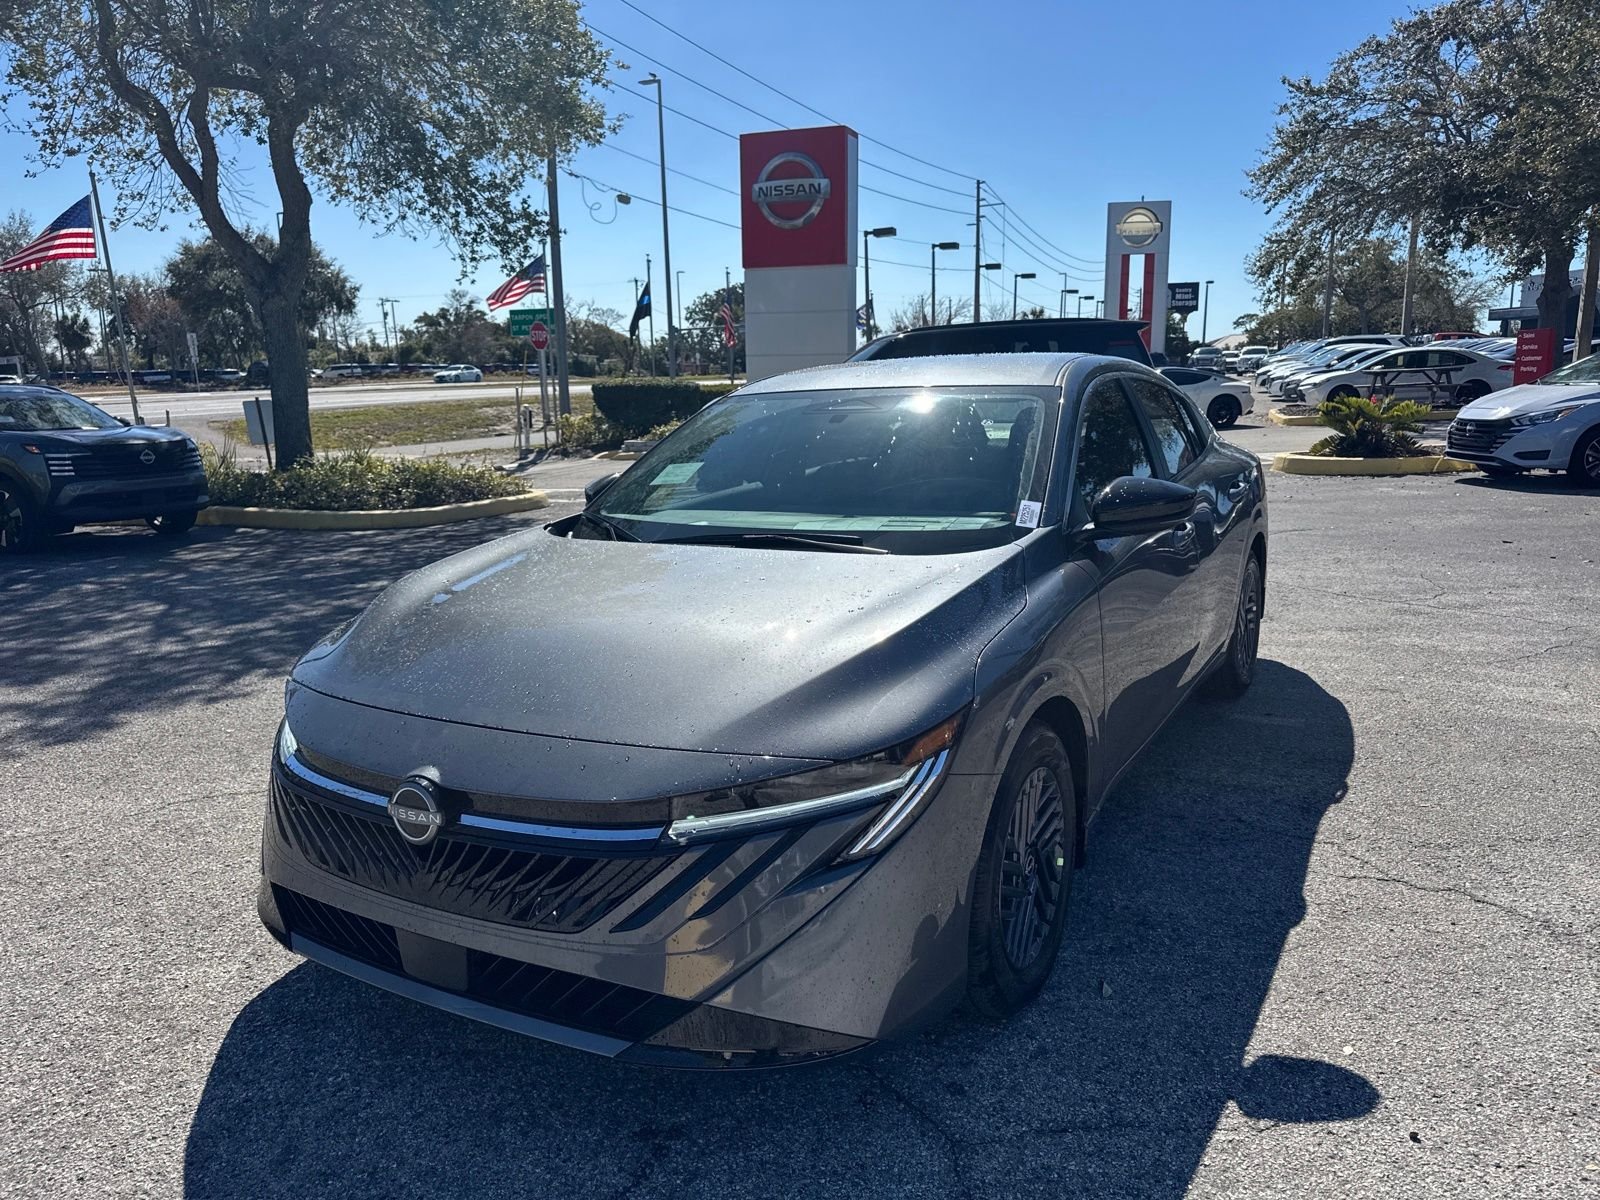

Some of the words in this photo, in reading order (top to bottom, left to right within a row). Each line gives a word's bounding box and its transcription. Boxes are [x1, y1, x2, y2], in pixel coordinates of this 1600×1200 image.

[757, 183, 822, 198] NISSAN
[531, 330, 547, 341] STOP
[388, 804, 440, 824] NISSAN
